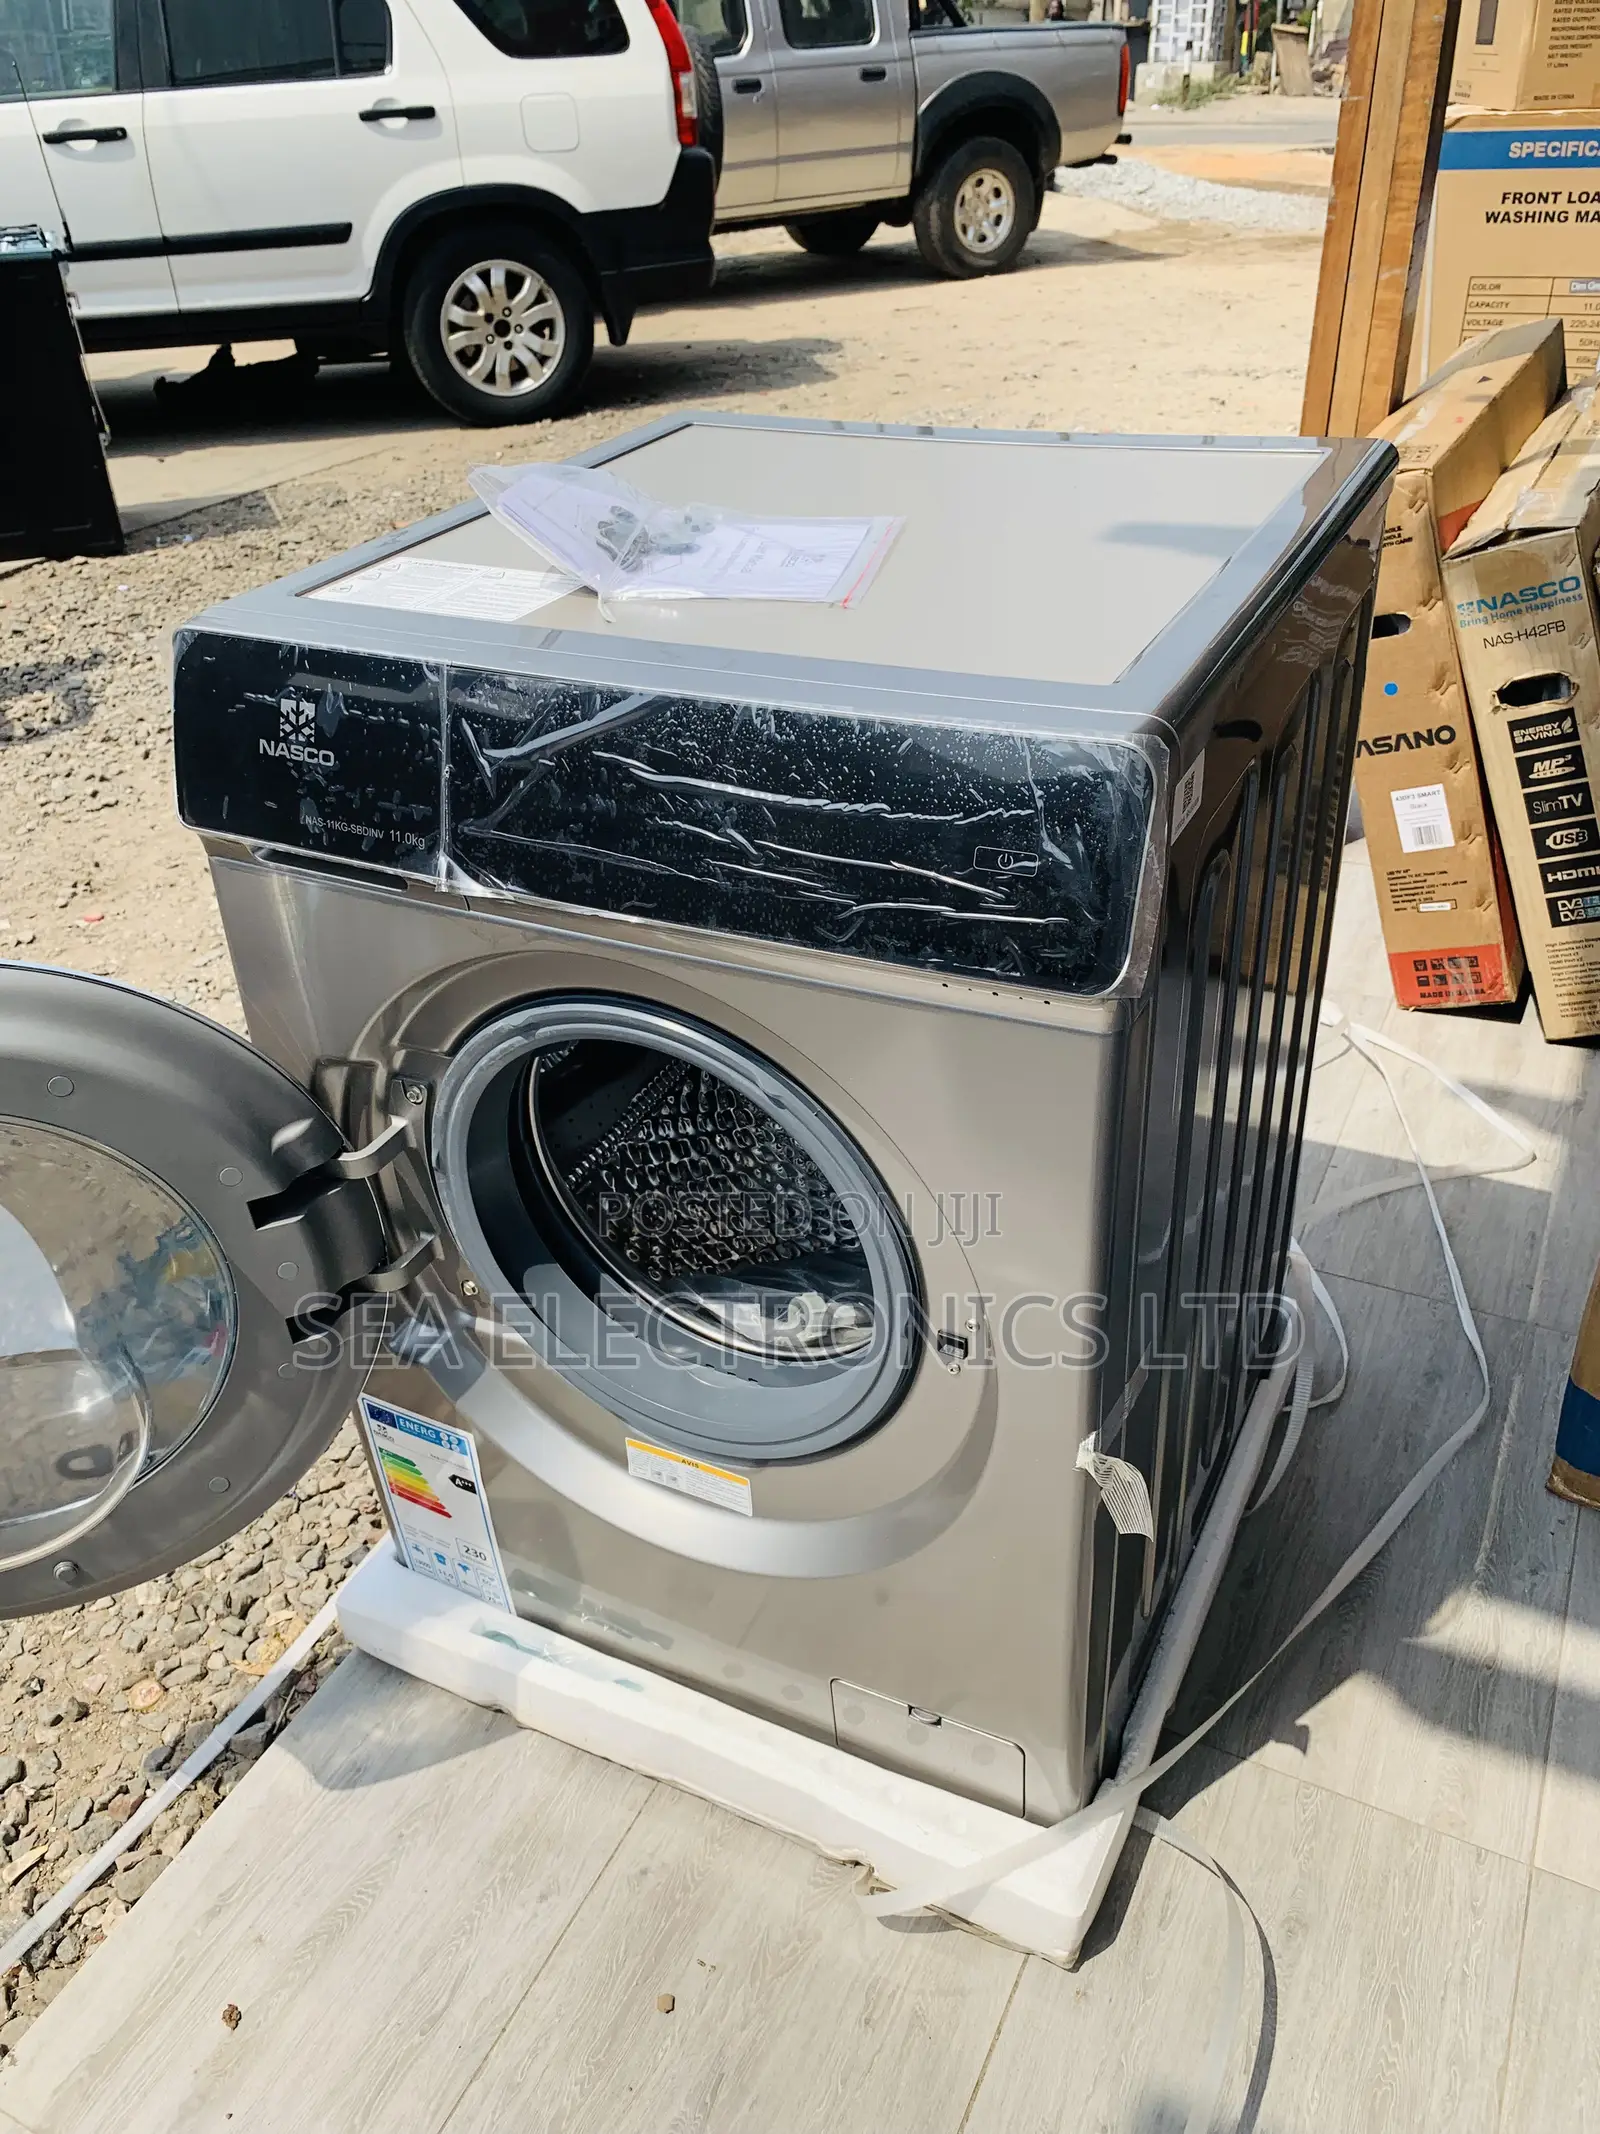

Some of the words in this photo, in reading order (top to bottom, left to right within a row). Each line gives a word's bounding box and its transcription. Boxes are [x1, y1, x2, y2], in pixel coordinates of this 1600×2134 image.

[1508, 140, 1600, 158] SPECIFIC
[1501, 191, 1562, 204] FRONT
[1485, 210, 1569, 224] WASHING
[1471, 283, 1502, 291] COLOR
[1468, 301, 1511, 309] CAPACITY
[1466, 319, 1504, 327] VOLTAGE
[1476, 575, 1581, 614] NASCO
[1459, 616, 1489, 629] Bring
[1490, 607, 1522, 621] Home
[1525, 593, 1584, 613] Happiness
[1482, 620, 1566, 650] NAS-H42FB
[1513, 722, 1559, 737] ENERGY
[1514, 728, 1562, 744] SAVING
[1356, 724, 1456, 759] ASANO
[259, 737, 335, 767] NASCO
[389, 830, 425, 849] 11.0kg
[1552, 829, 1588, 846] USB
[1420, 991, 1443, 999] MADE
[399, 1418, 437, 1439] ENERG
[681, 1458, 700, 1469] AVIS
[463, 1544, 487, 1561] 230
